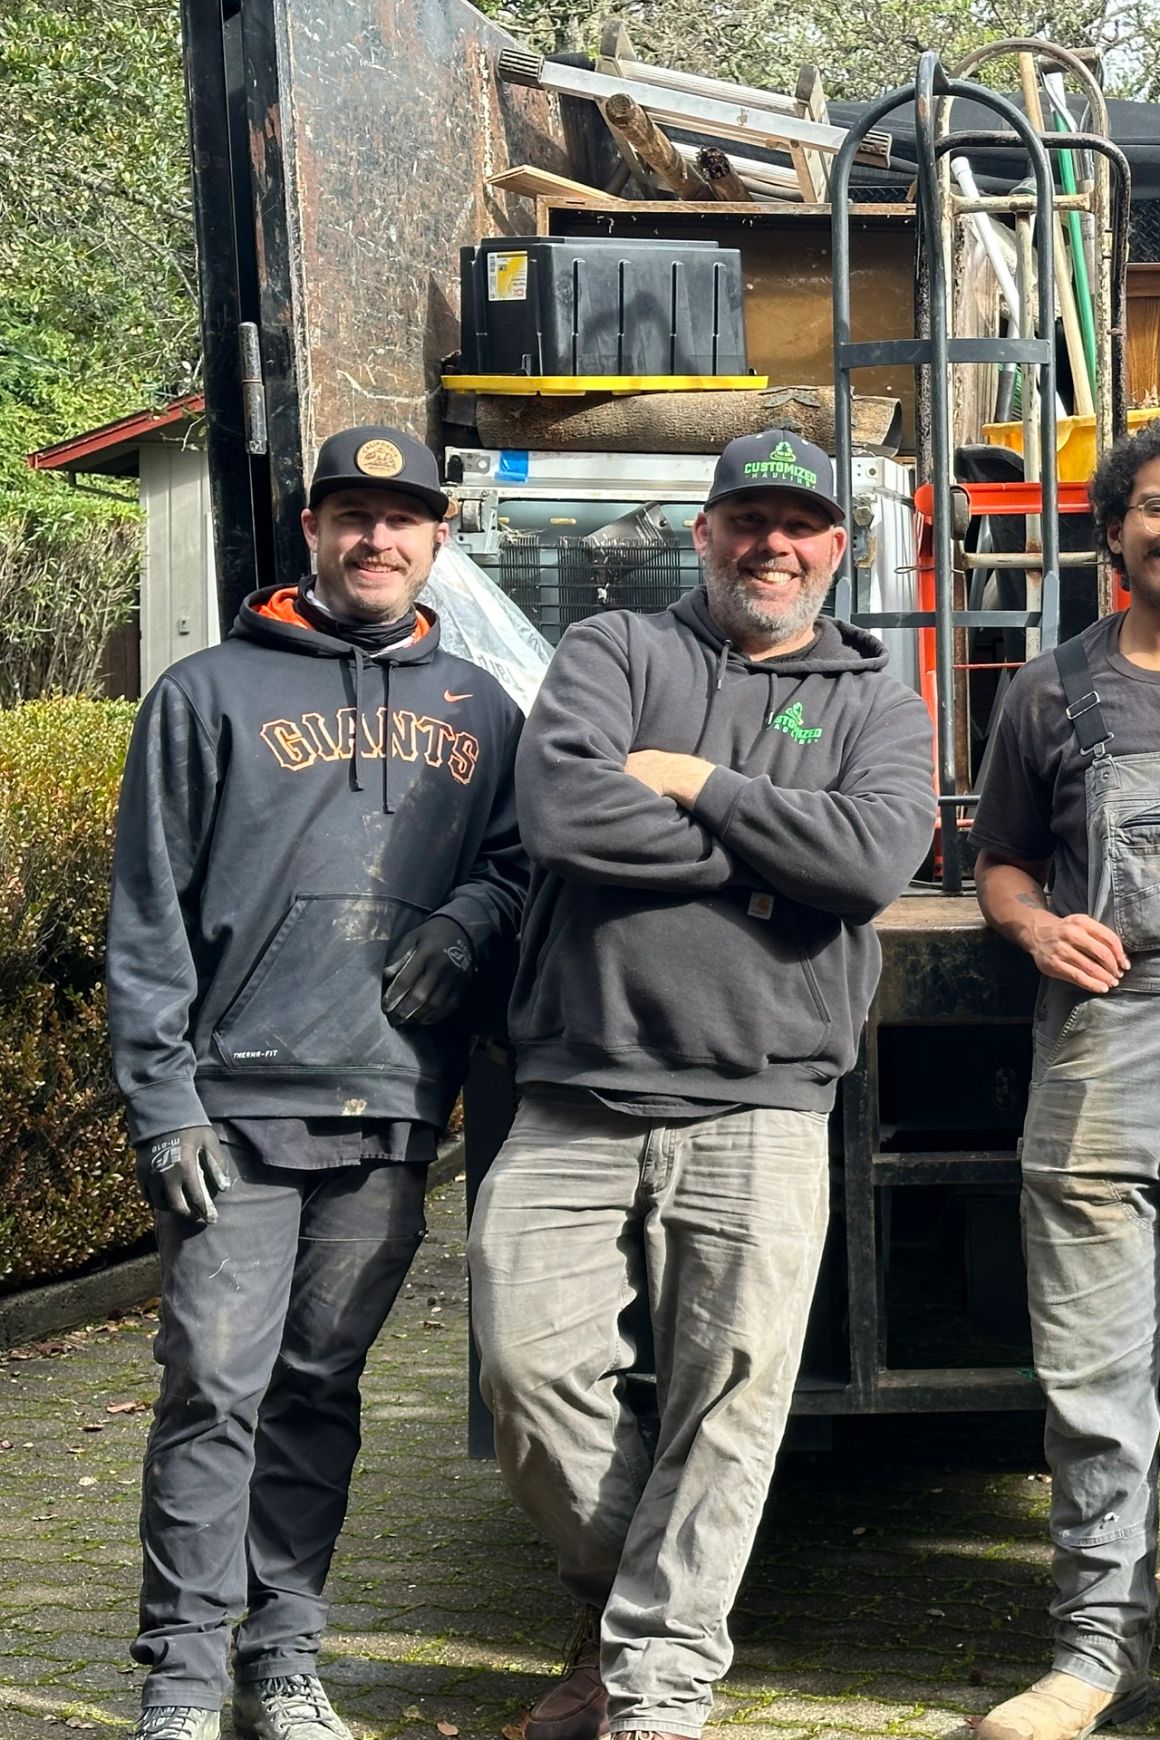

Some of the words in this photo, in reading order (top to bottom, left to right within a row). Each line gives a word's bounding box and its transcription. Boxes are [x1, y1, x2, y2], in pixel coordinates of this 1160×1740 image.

[362, 442, 398, 457] CALIFORNIA
[744, 461, 817, 484] CUSTOMIZED
[260, 706, 480, 785] GIANTS
[233, 1049, 279, 1059] THERMA-FIT
